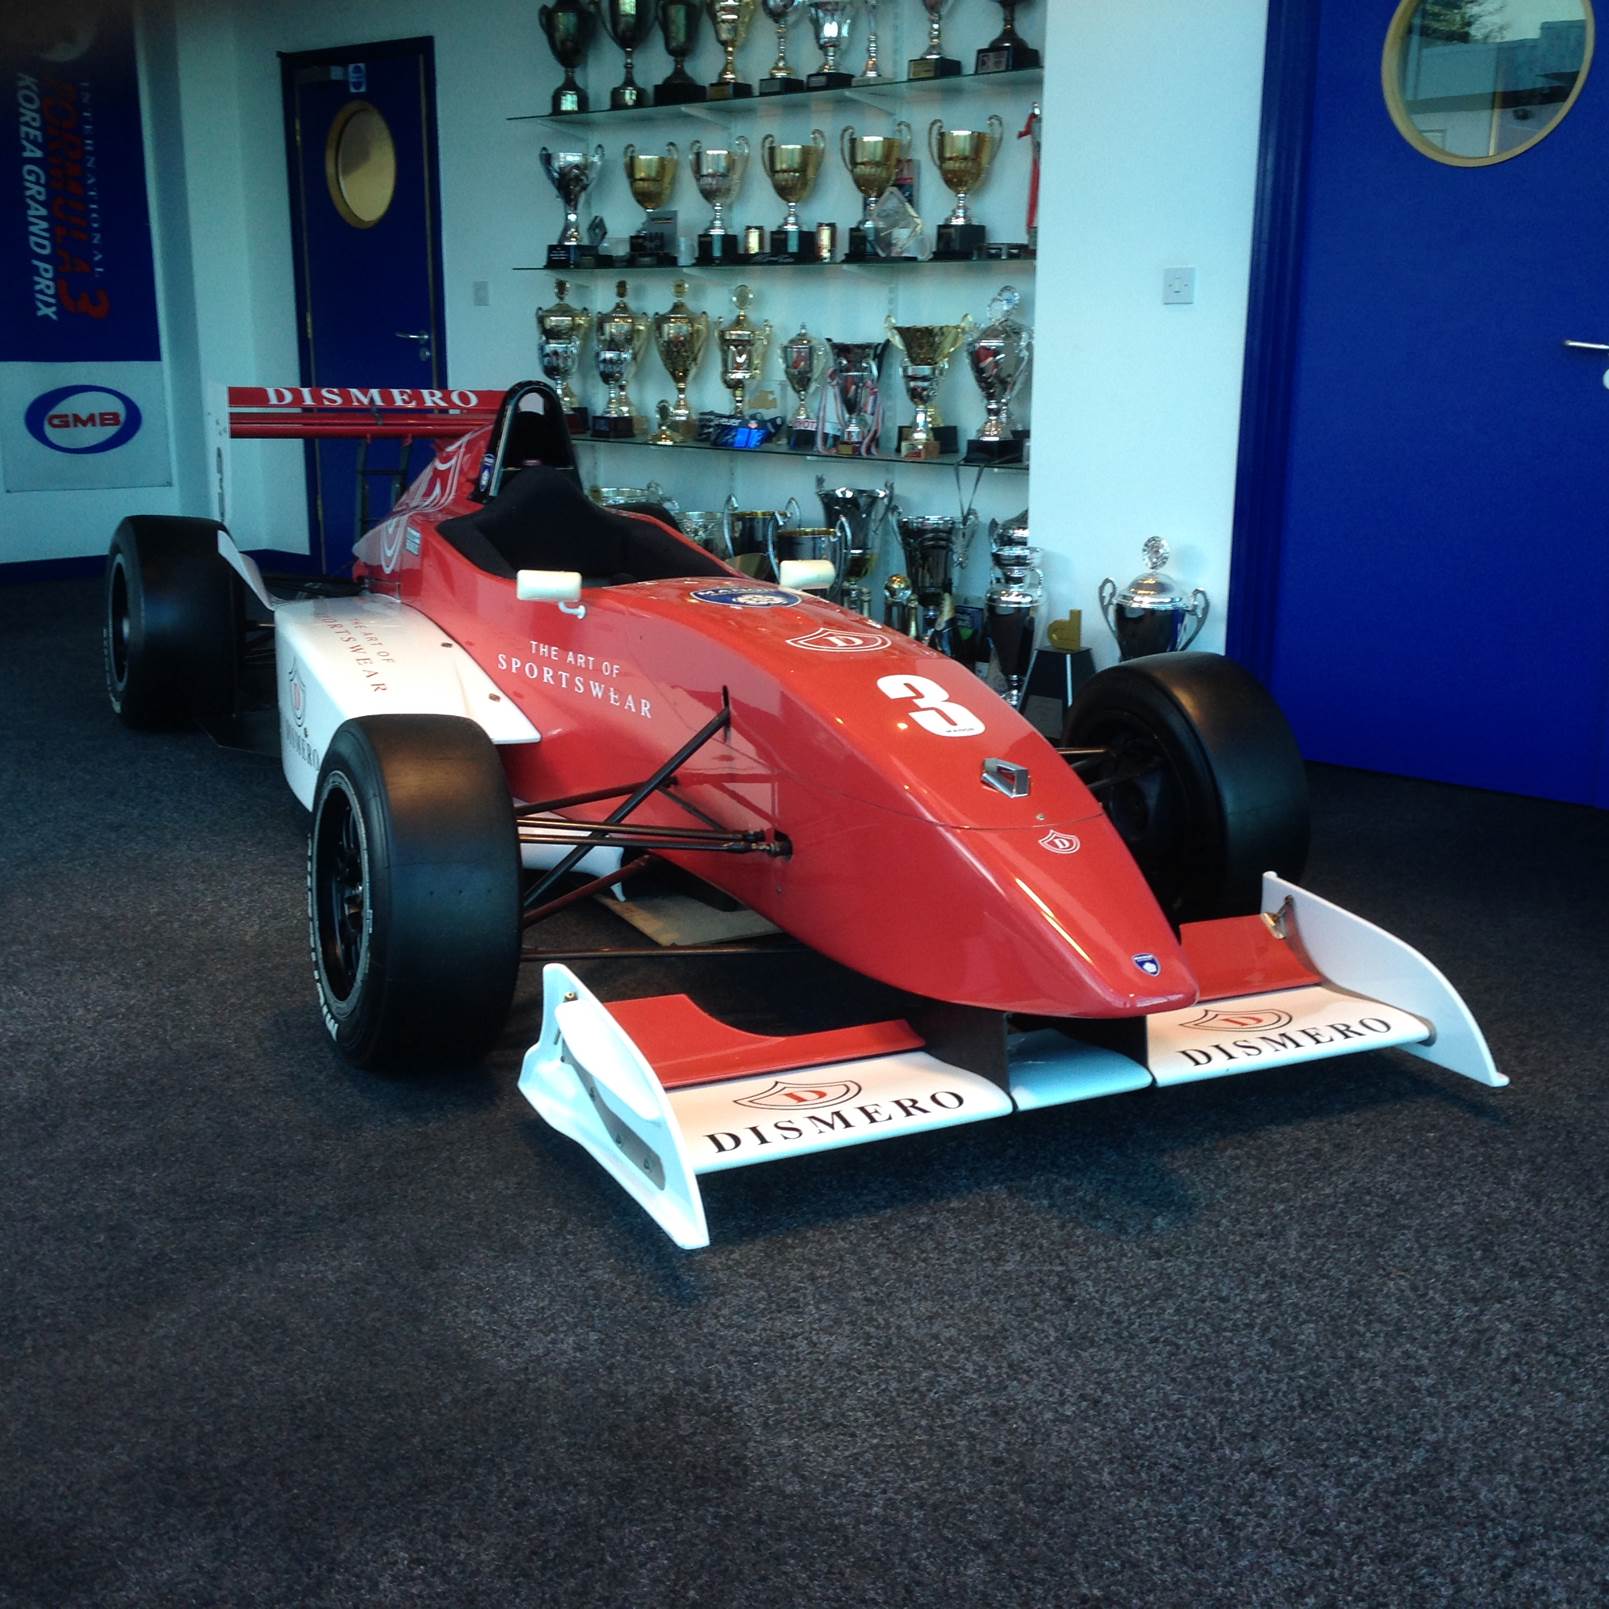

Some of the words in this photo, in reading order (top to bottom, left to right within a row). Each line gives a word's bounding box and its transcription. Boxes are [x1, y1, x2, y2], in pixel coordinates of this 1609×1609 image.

[16, 73, 43, 158] KOREA
[43, 79, 91, 272] FORMULA
[79, 80, 104, 278] INTERNATIONAL
[22, 164, 51, 255] GRAND
[31, 259, 58, 320] PRIX
[56, 278, 111, 319] 3
[47, 411, 121, 428] GMB
[265, 387, 479, 407] DISMERO
[318, 614, 388, 692] ORTSWEAR
[376, 651, 395, 664] OF
[530, 641, 559, 660] THE
[566, 651, 595, 670] ART
[602, 662, 620, 678] OF
[497, 654, 652, 718] SPORTSWEAR
[876, 674, 986, 737] 3
[1177, 1017, 1392, 1067] DISMERO
[705, 1090, 965, 1154] DISMERO
